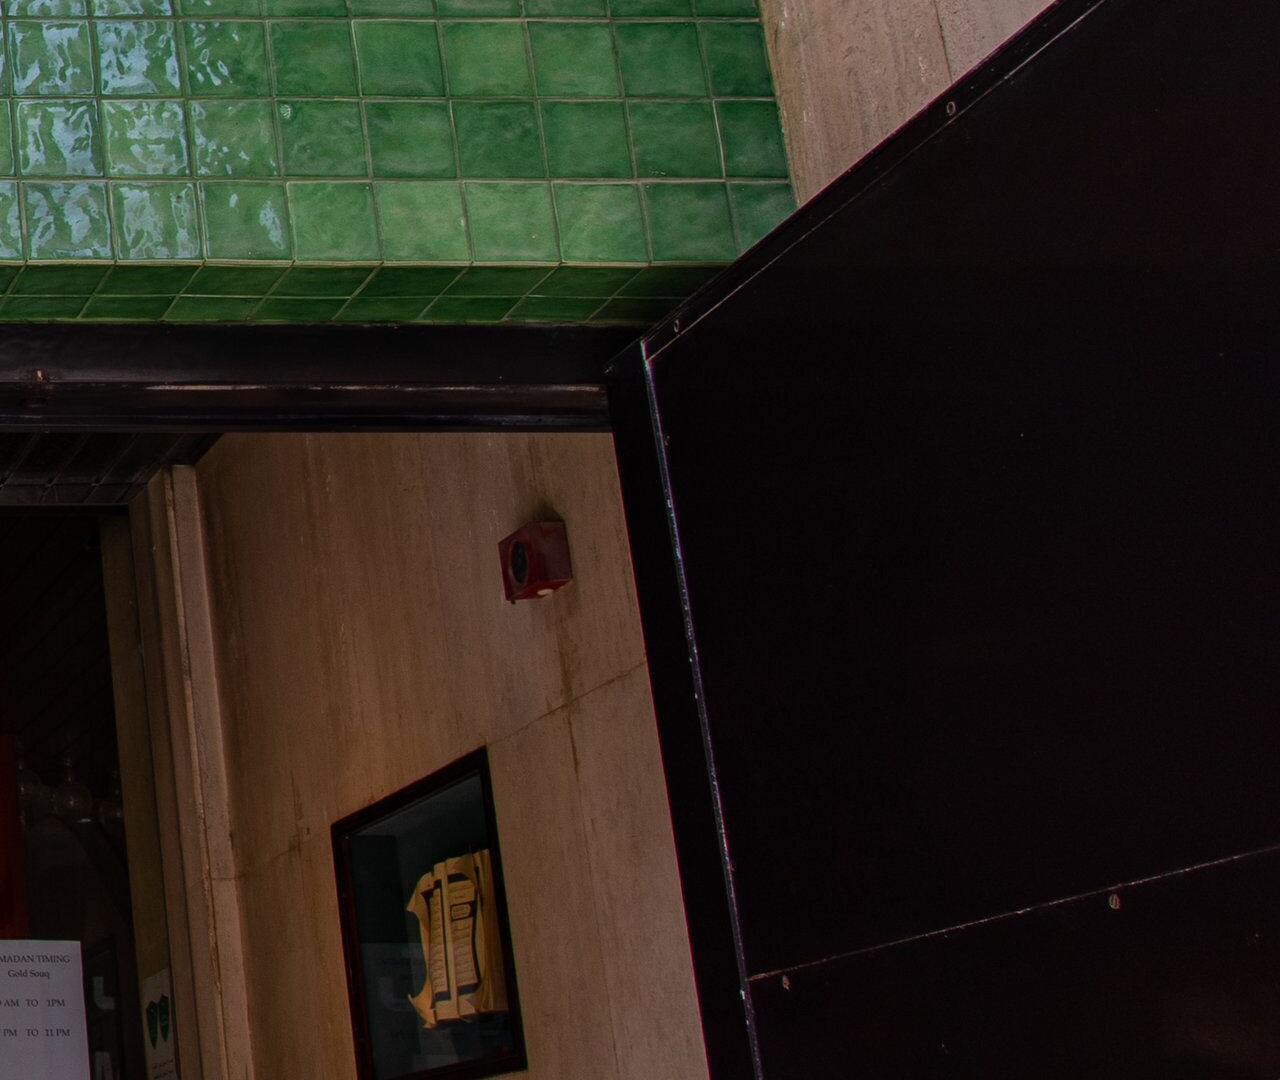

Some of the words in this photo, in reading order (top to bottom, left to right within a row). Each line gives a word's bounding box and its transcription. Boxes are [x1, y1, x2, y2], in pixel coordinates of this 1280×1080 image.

[36, 954, 71, 964] TIMING
[8, 968, 28, 978] Gold
[29, 969, 50, 980] Souq
[4, 999, 19, 1007] AM
[25, 999, 38, 1007] TO
[3, 1029, 17, 1037] PM
[25, 1029, 38, 1037] TO
[45, 1029, 53, 1037] 11
[56, 1029, 71, 1037] PM
